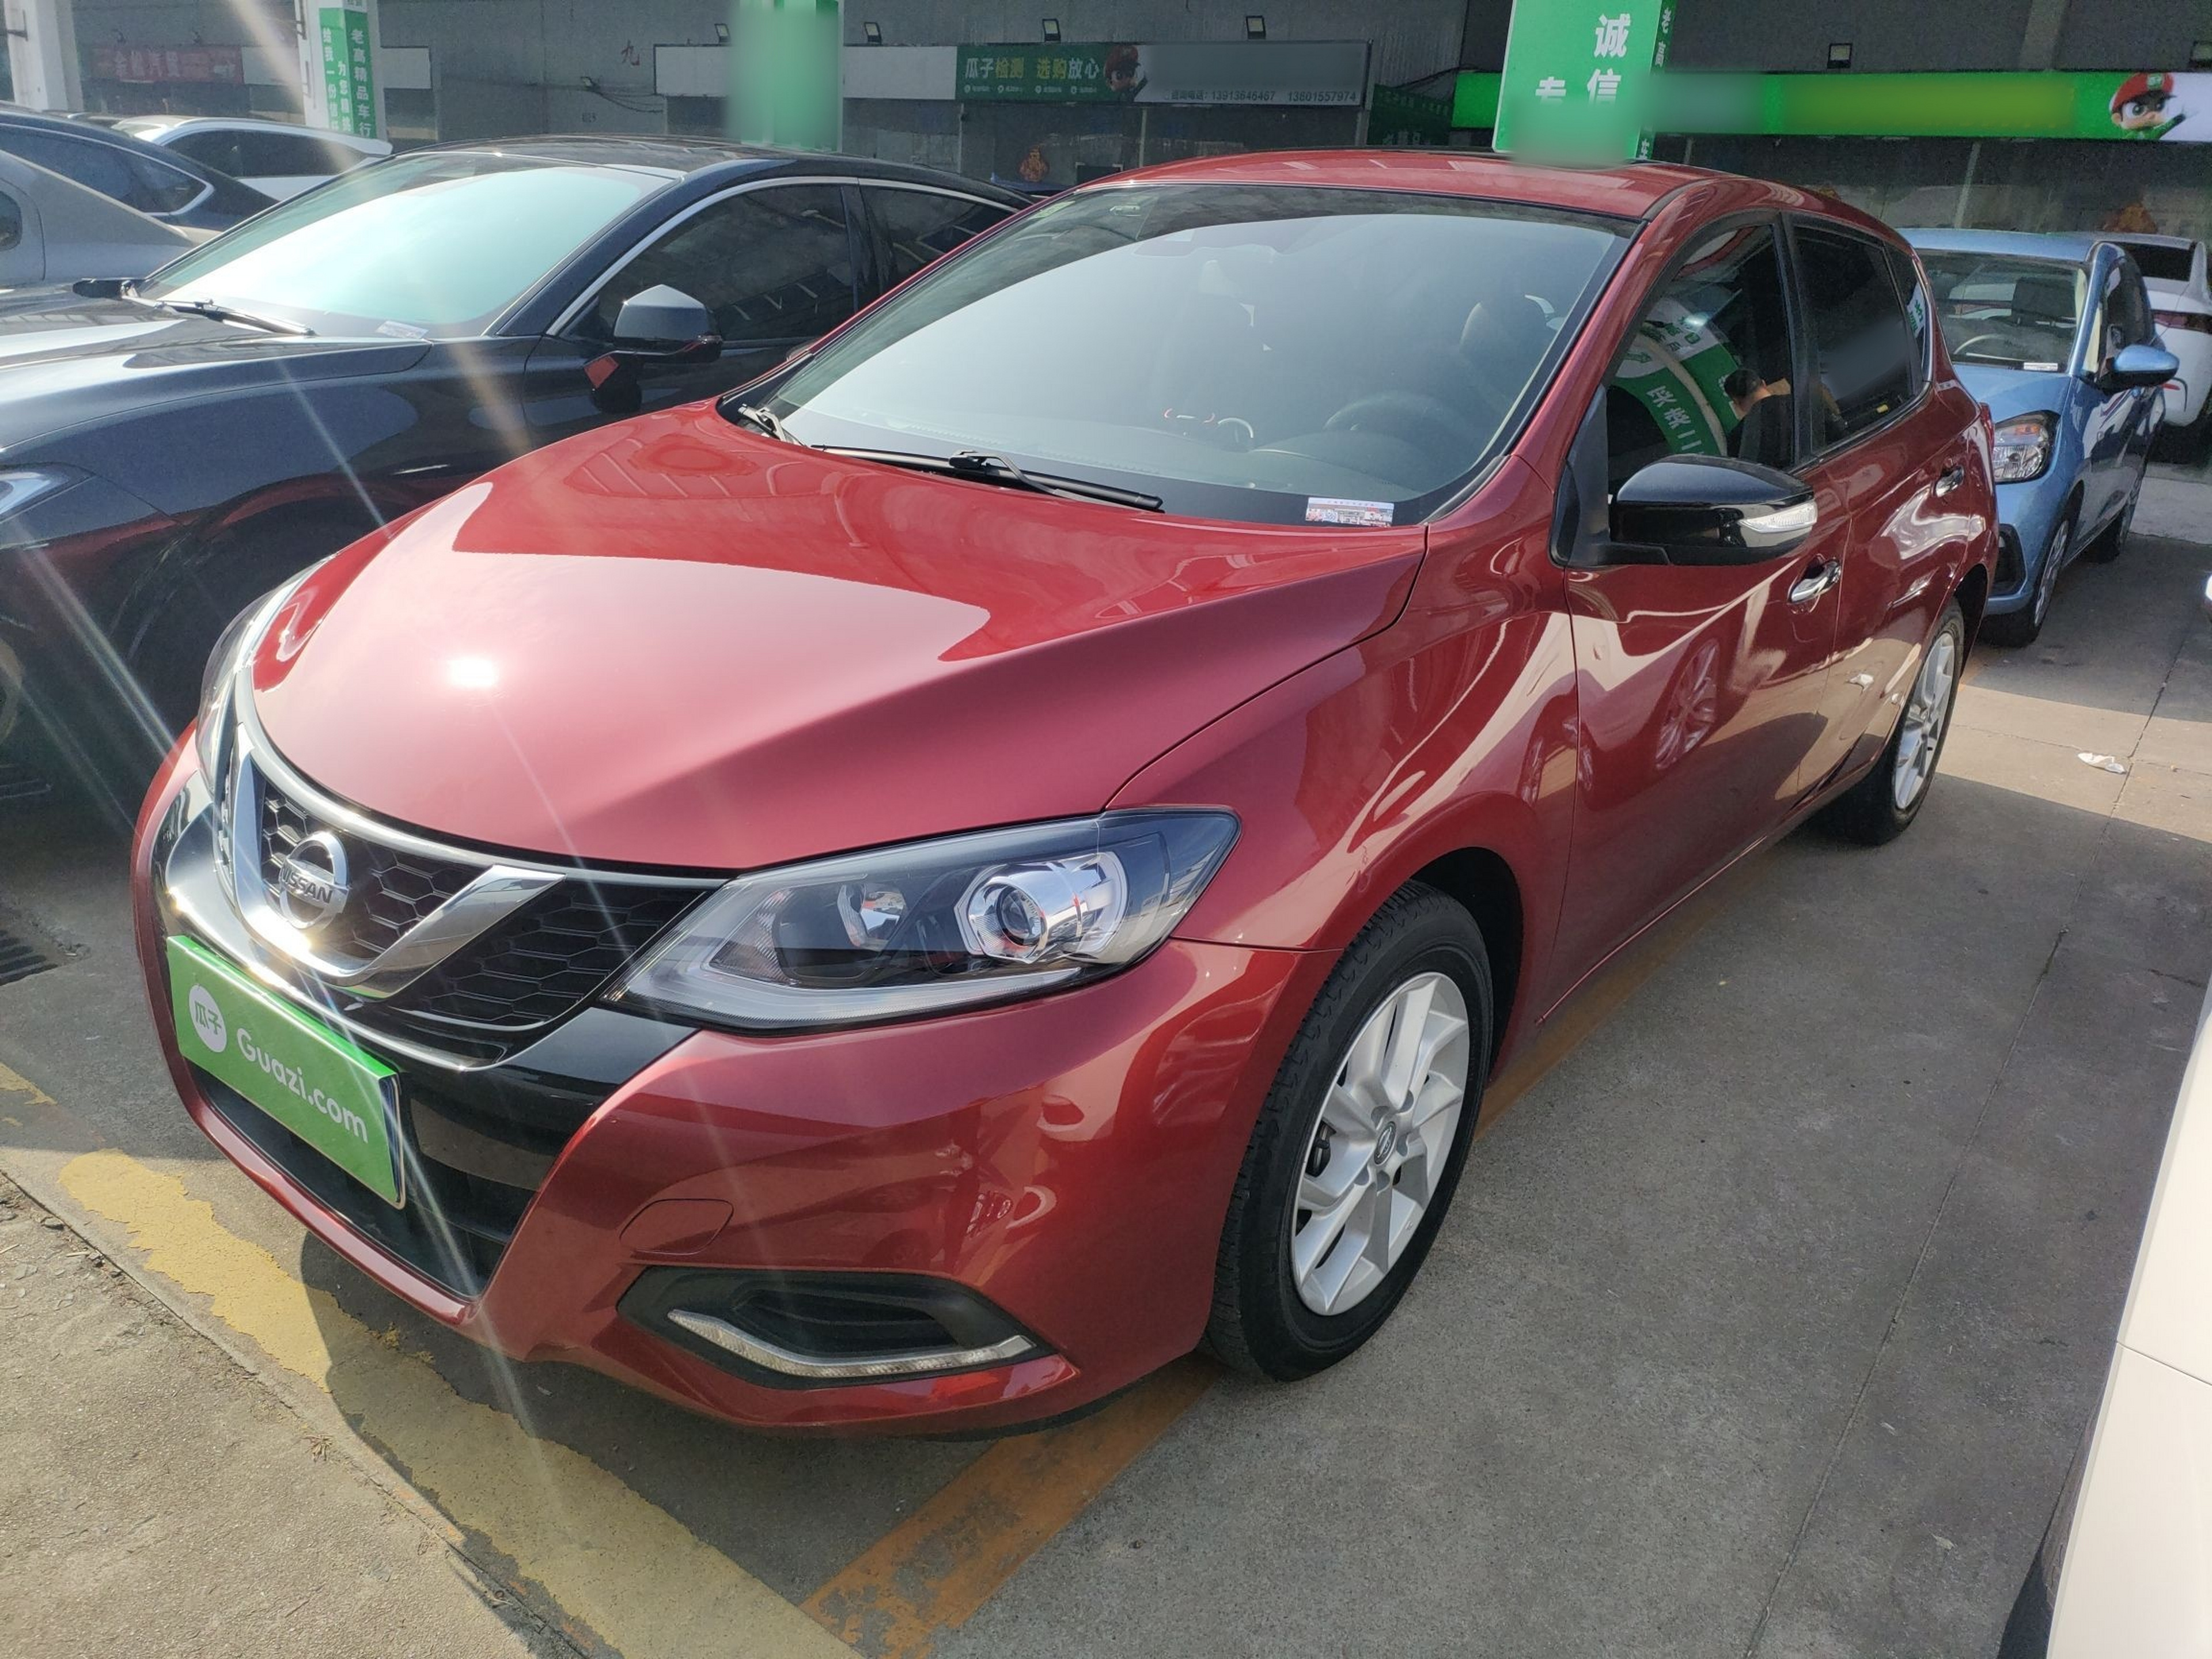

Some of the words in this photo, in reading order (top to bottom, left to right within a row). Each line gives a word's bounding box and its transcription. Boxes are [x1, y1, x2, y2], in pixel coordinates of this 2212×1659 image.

[351, 29, 372, 137] 老高精品车行
[194, 1001, 221, 1035] 瓜子
[237, 1028, 369, 1144] Guazi.com
